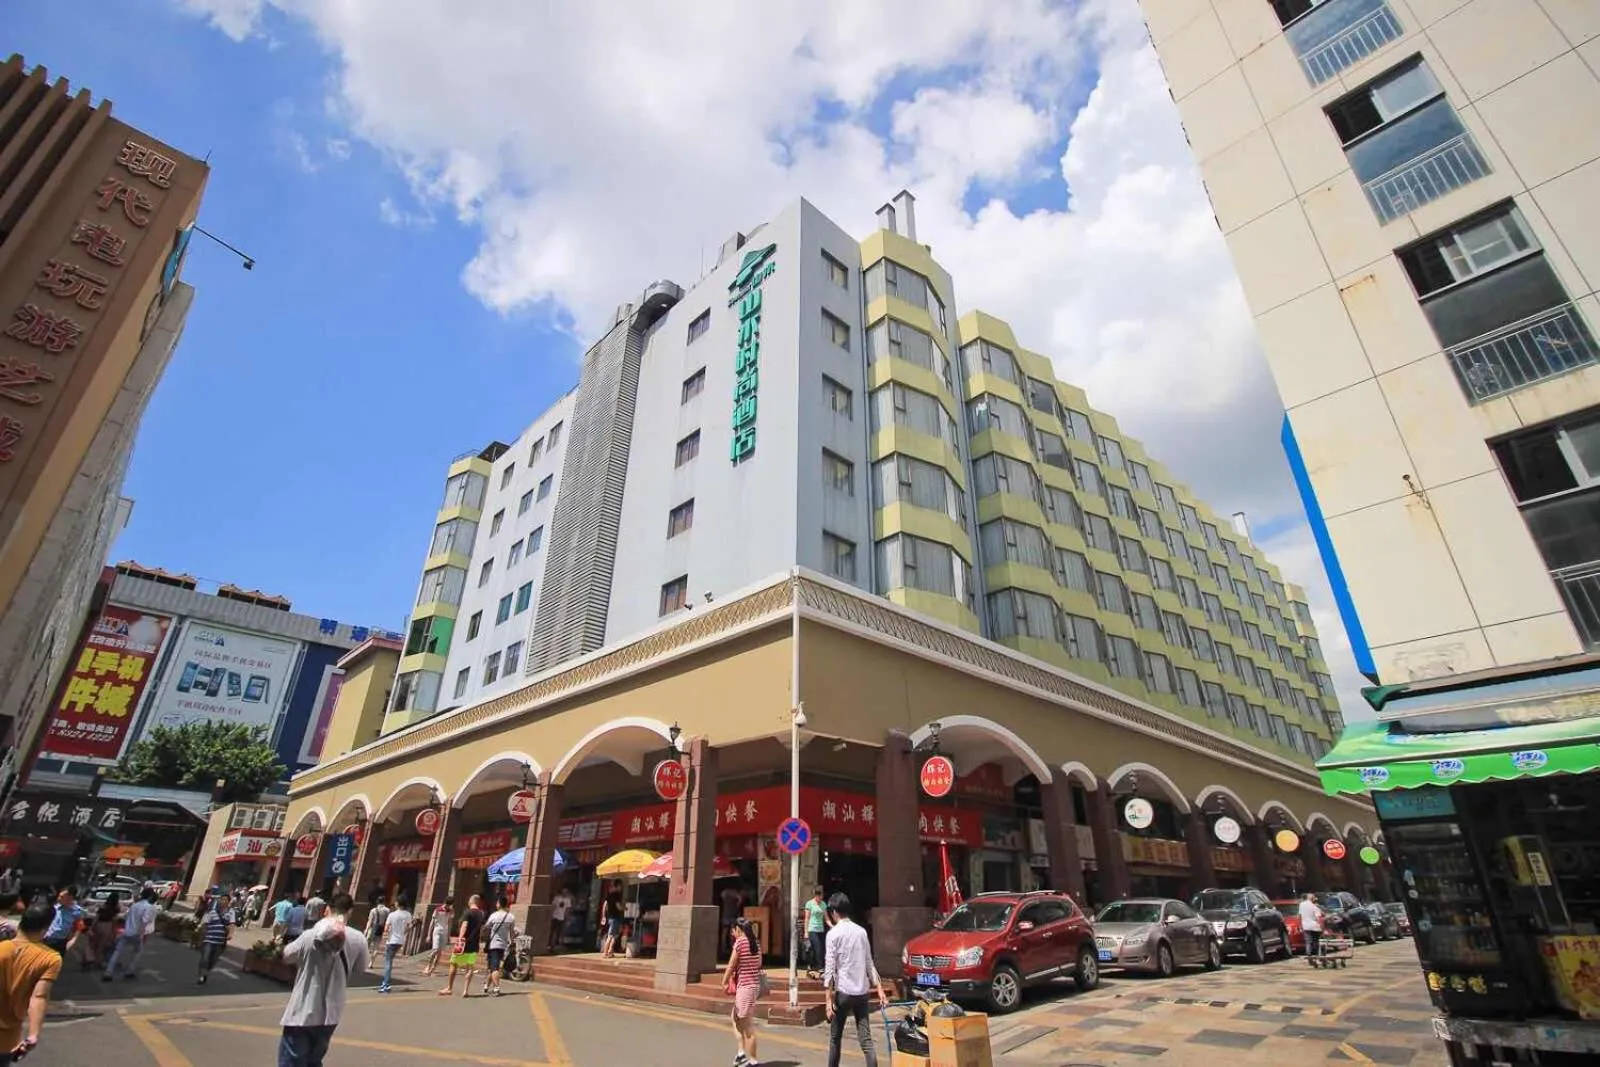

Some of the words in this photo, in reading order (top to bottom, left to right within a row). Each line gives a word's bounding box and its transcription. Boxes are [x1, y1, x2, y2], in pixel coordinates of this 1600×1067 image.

[730, 288, 762, 467] 山水时尚酒店
